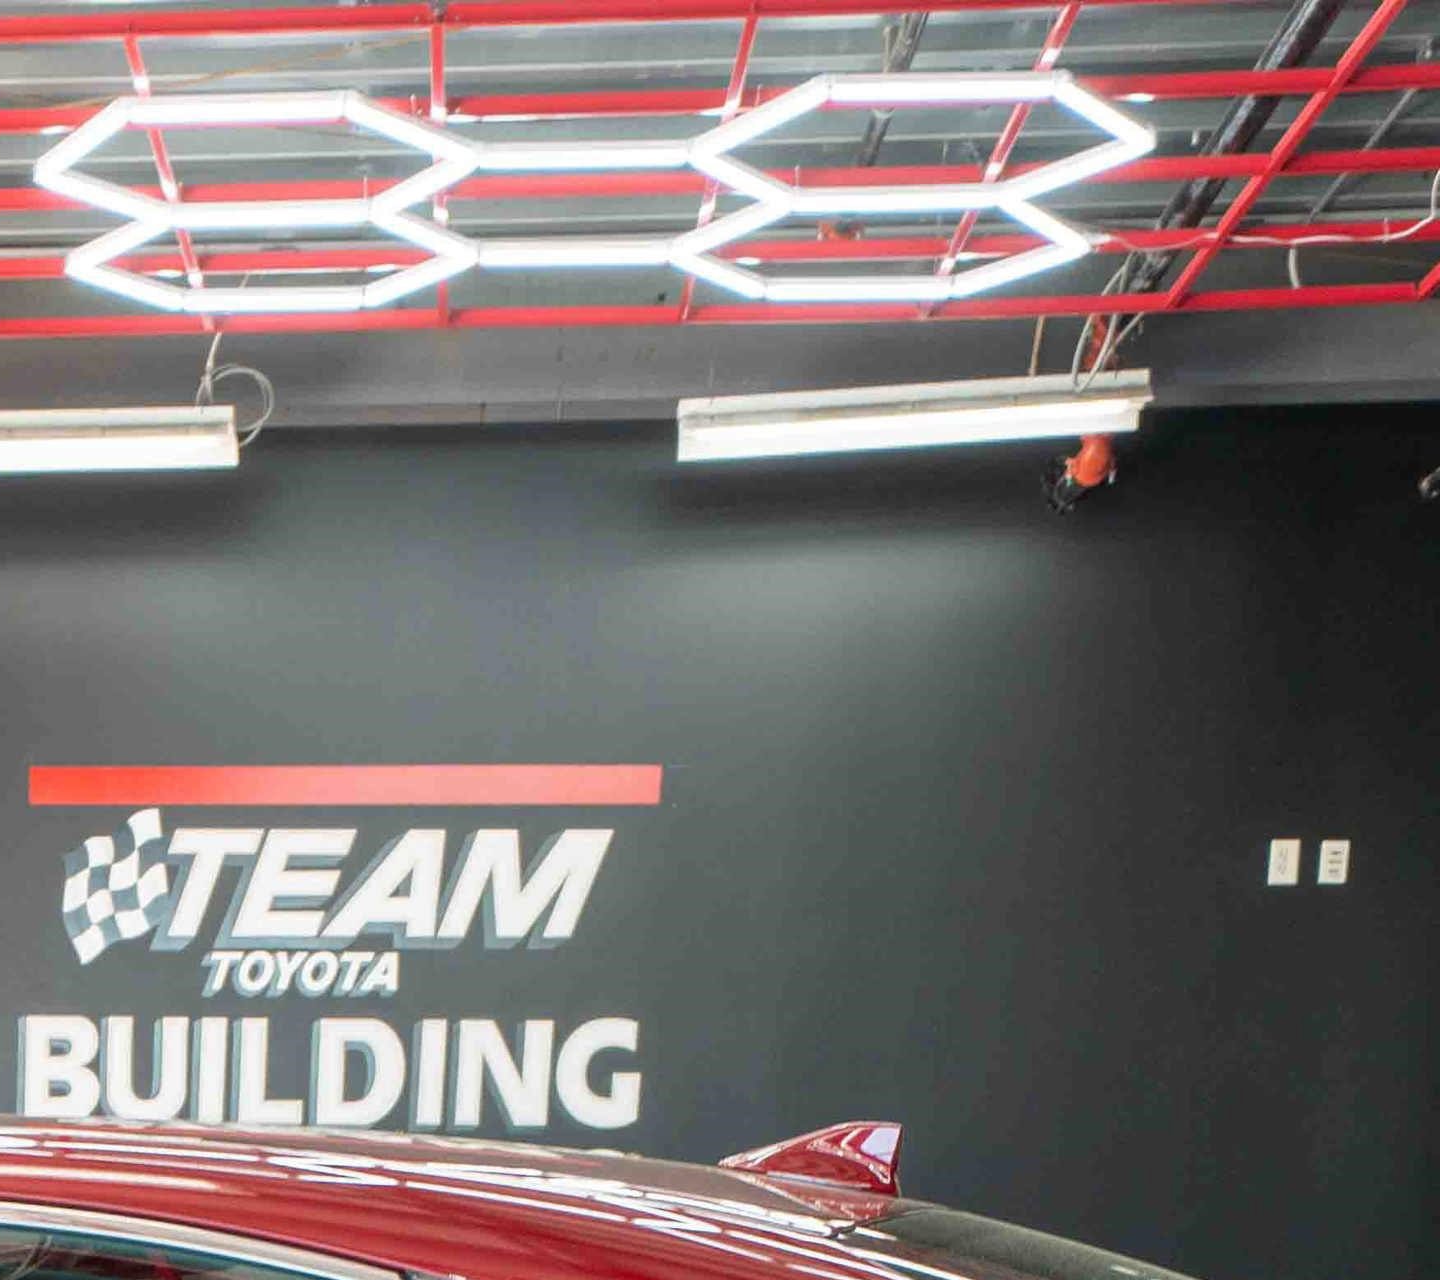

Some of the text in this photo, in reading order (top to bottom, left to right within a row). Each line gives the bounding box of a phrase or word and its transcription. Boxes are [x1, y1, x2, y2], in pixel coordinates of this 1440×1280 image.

[154, 828, 615, 946] TEAM
[203, 950, 400, 996] TOYOTA
[19, 1014, 643, 1129] BUILDING
